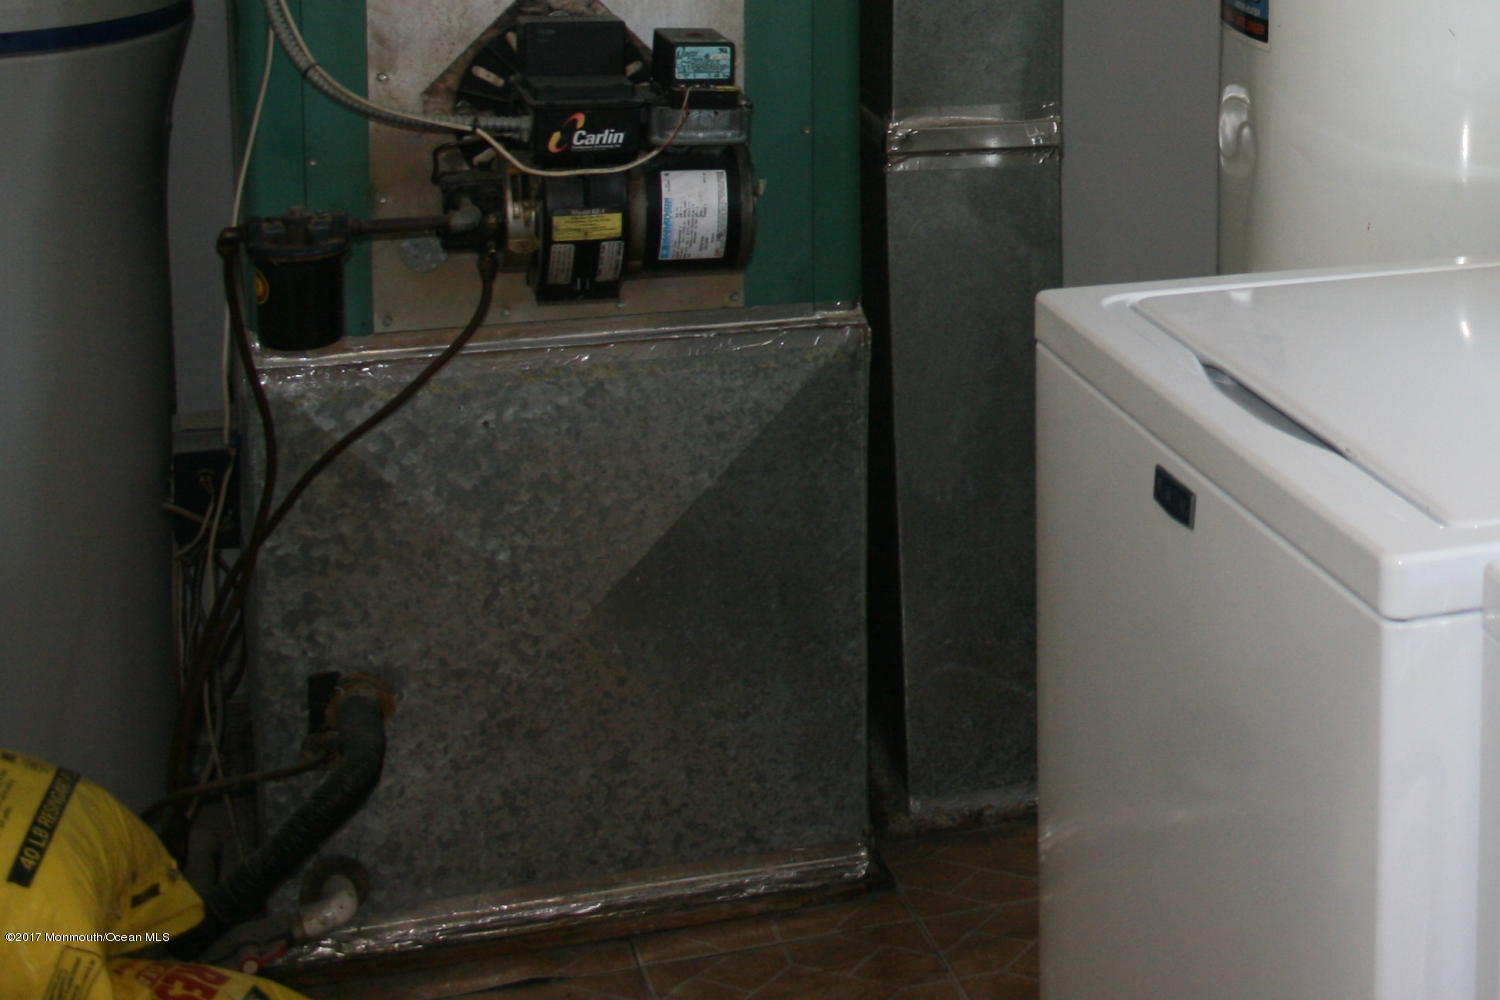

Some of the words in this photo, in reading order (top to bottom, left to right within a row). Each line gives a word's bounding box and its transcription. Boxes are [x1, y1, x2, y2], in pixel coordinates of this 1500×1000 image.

[572, 128, 625, 146] Carlin
[28, 826, 49, 848] LB
[20, 846, 41, 871] 40
